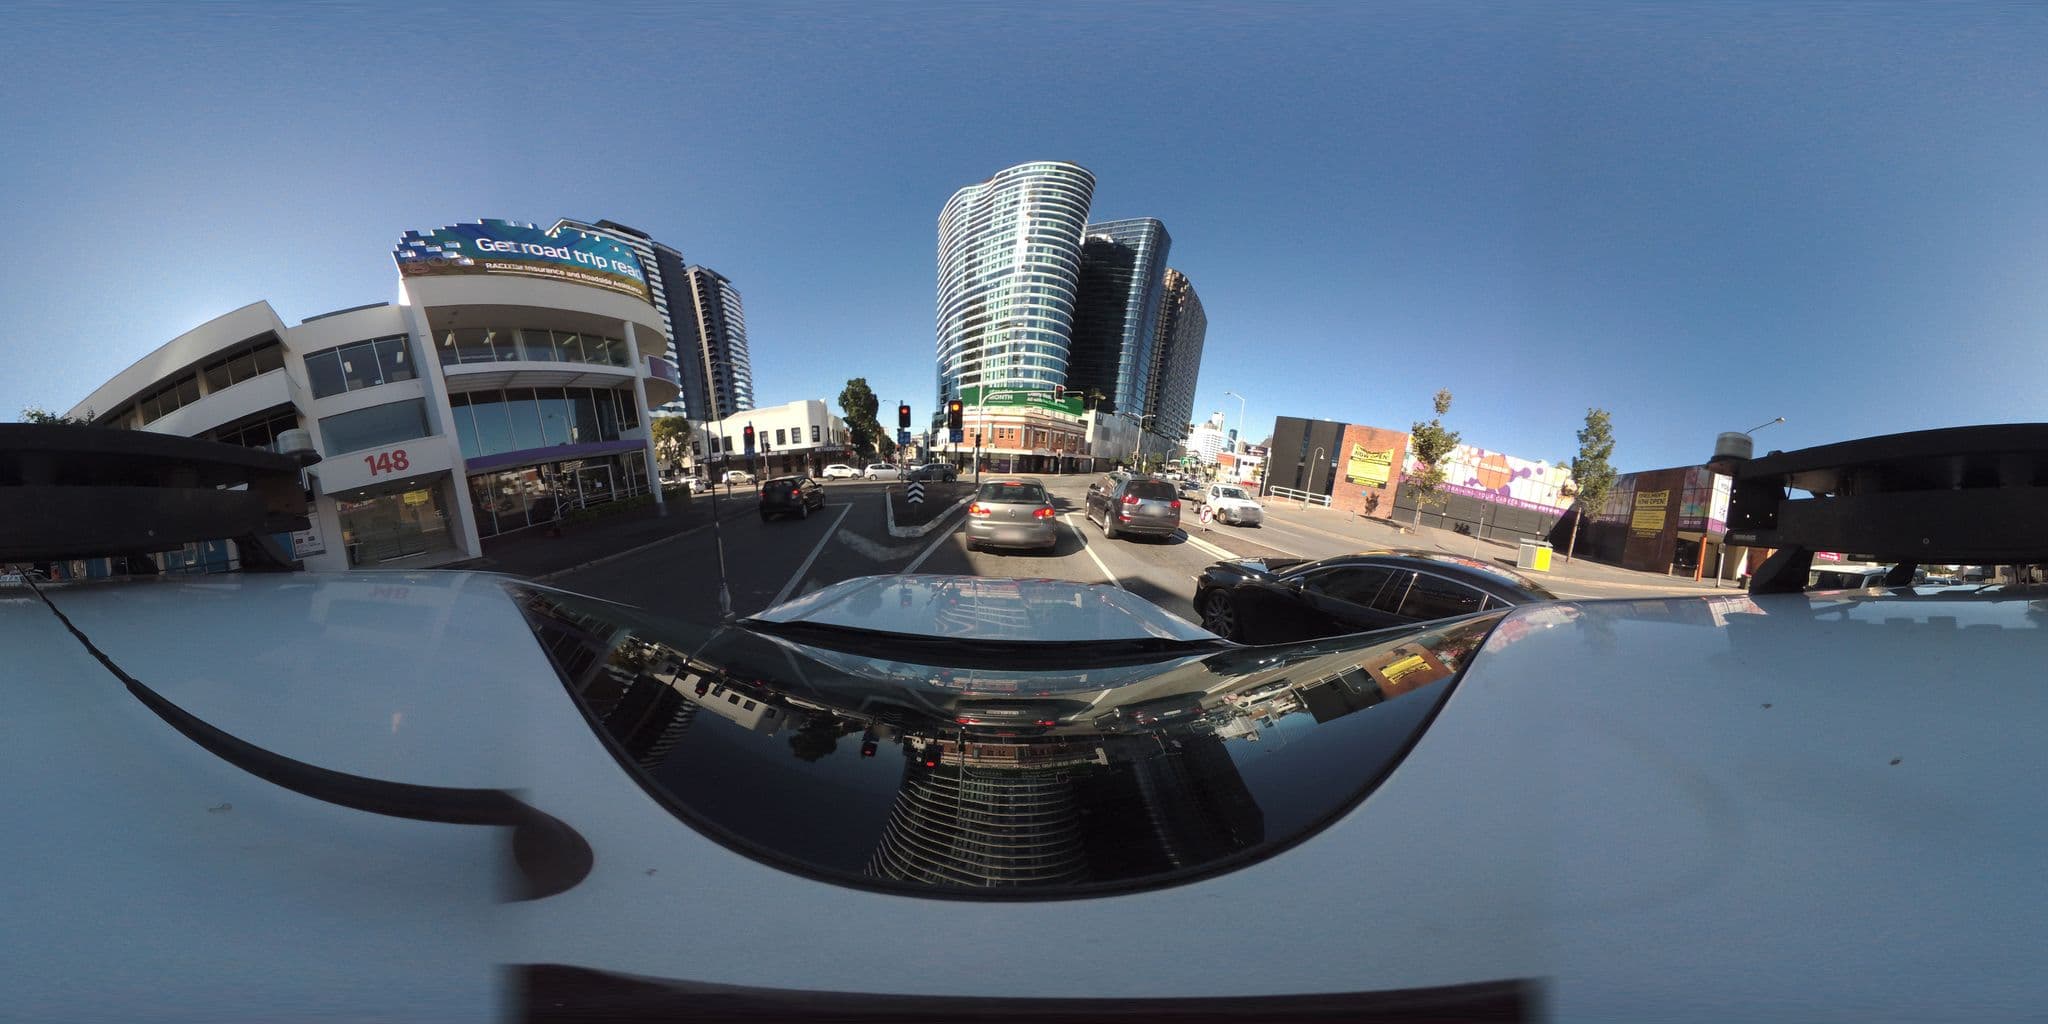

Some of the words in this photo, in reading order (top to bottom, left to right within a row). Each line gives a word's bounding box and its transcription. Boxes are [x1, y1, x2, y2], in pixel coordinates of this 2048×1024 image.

[475, 238, 516, 253] Get
[519, 241, 571, 260] road
[572, 249, 608, 269] trip
[566, 271, 580, 279] and
[364, 449, 410, 477] 148
